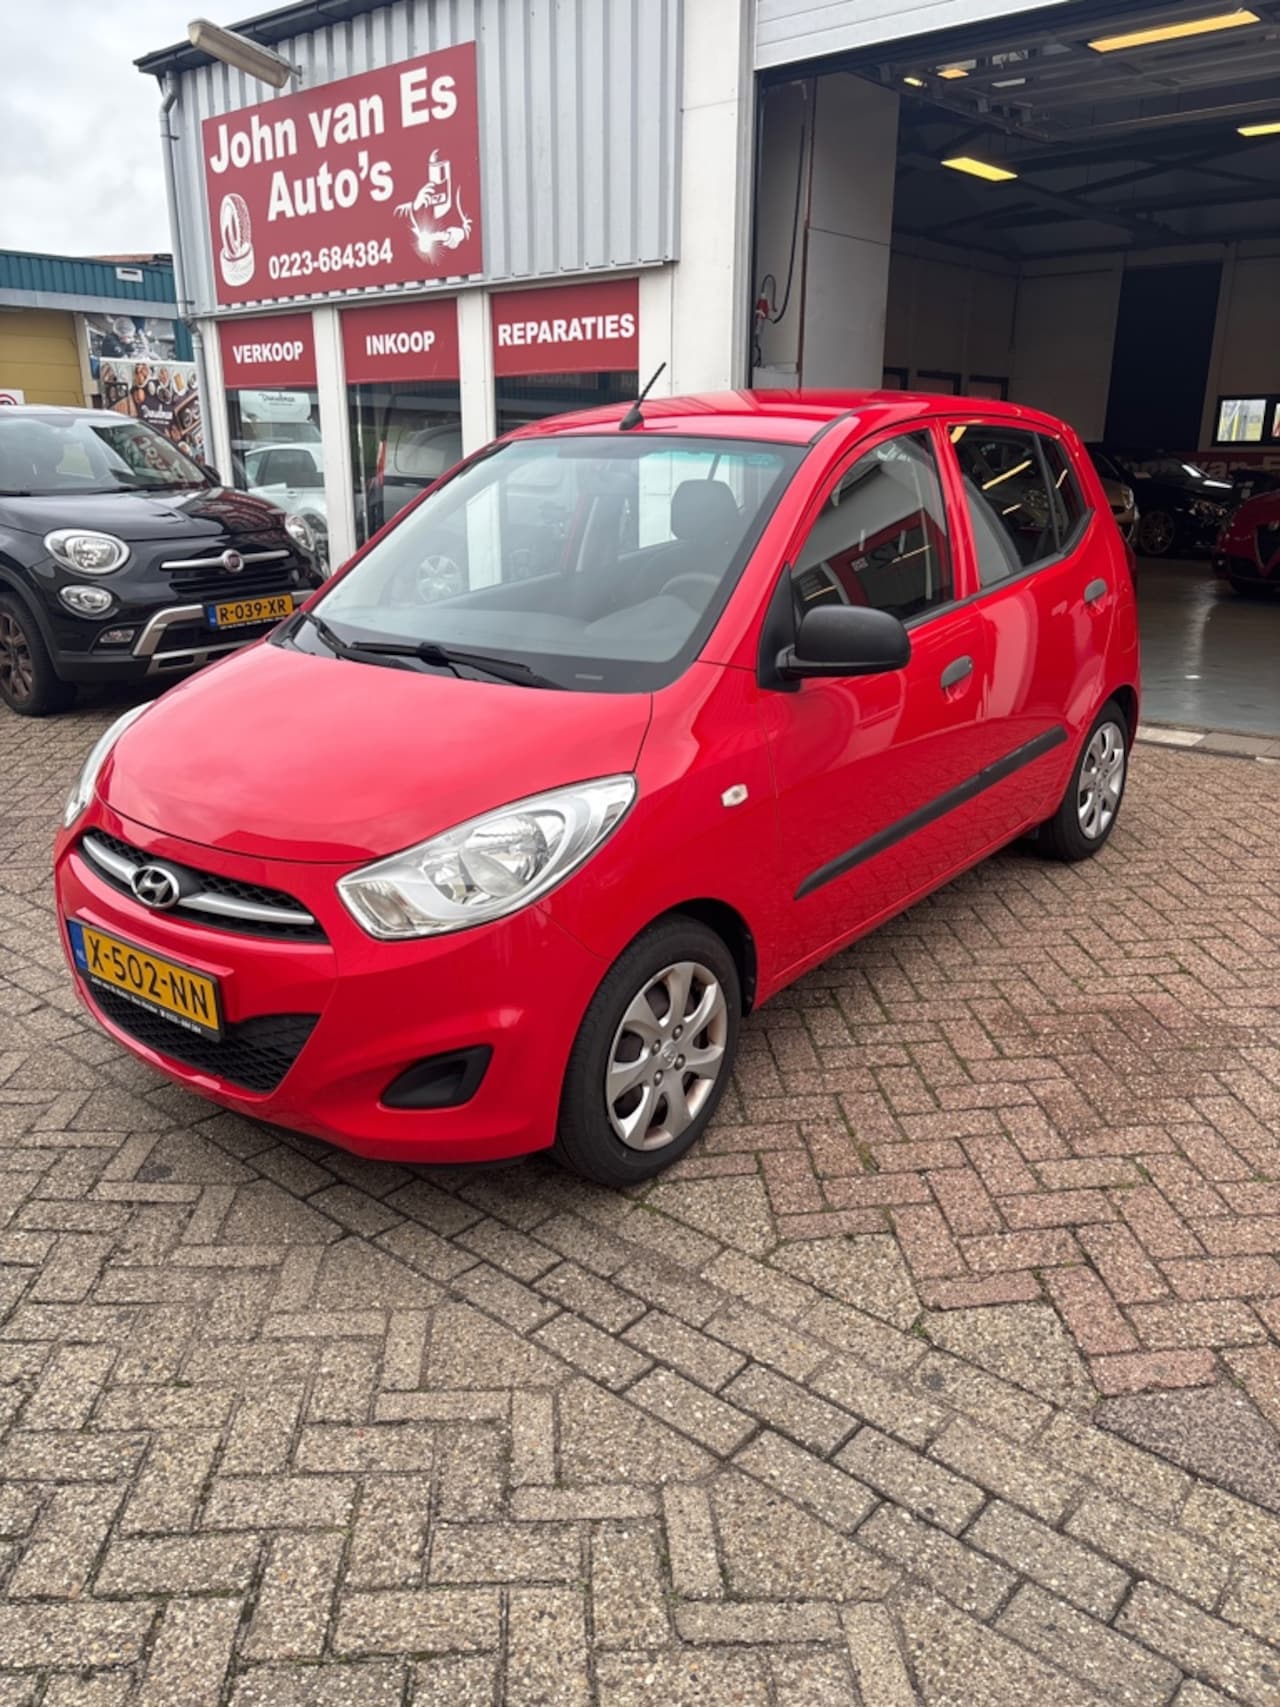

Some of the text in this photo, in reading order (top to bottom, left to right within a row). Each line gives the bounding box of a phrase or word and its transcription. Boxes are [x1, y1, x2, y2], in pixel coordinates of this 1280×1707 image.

[209, 66, 458, 174] John van Es
[267, 150, 394, 222] Auto's
[268, 237, 393, 280] 0223-684384
[365, 330, 436, 356] INKOOP
[497, 313, 636, 347] REPARATIES
[232, 341, 304, 364] VERKOOP
[219, 598, 287, 623] R-039-XR
[88, 935, 210, 1020] X-502-NN
